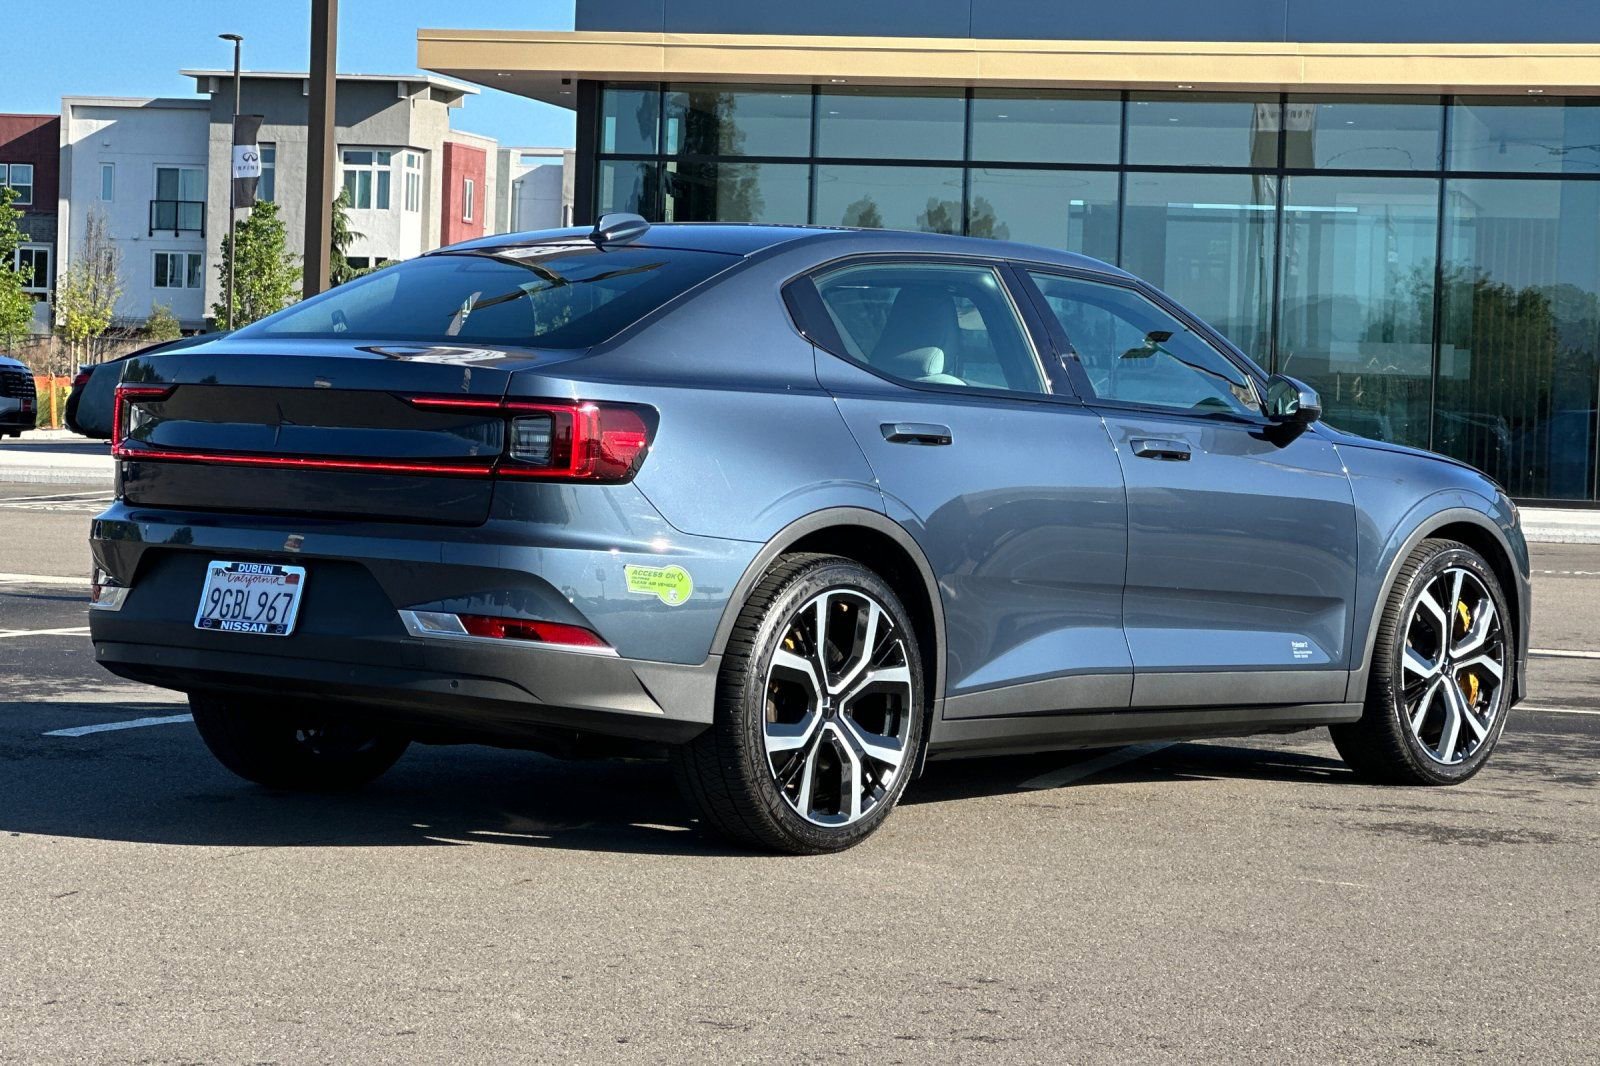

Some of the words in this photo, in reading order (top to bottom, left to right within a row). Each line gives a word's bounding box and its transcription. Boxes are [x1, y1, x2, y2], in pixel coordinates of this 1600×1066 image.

[238, 564, 273, 574] DUBLIN
[632, 569, 663, 578] ACCESS
[228, 574, 280, 588] California
[207, 587, 293, 624] 9GBL967
[221, 620, 268, 632] NISSAN
